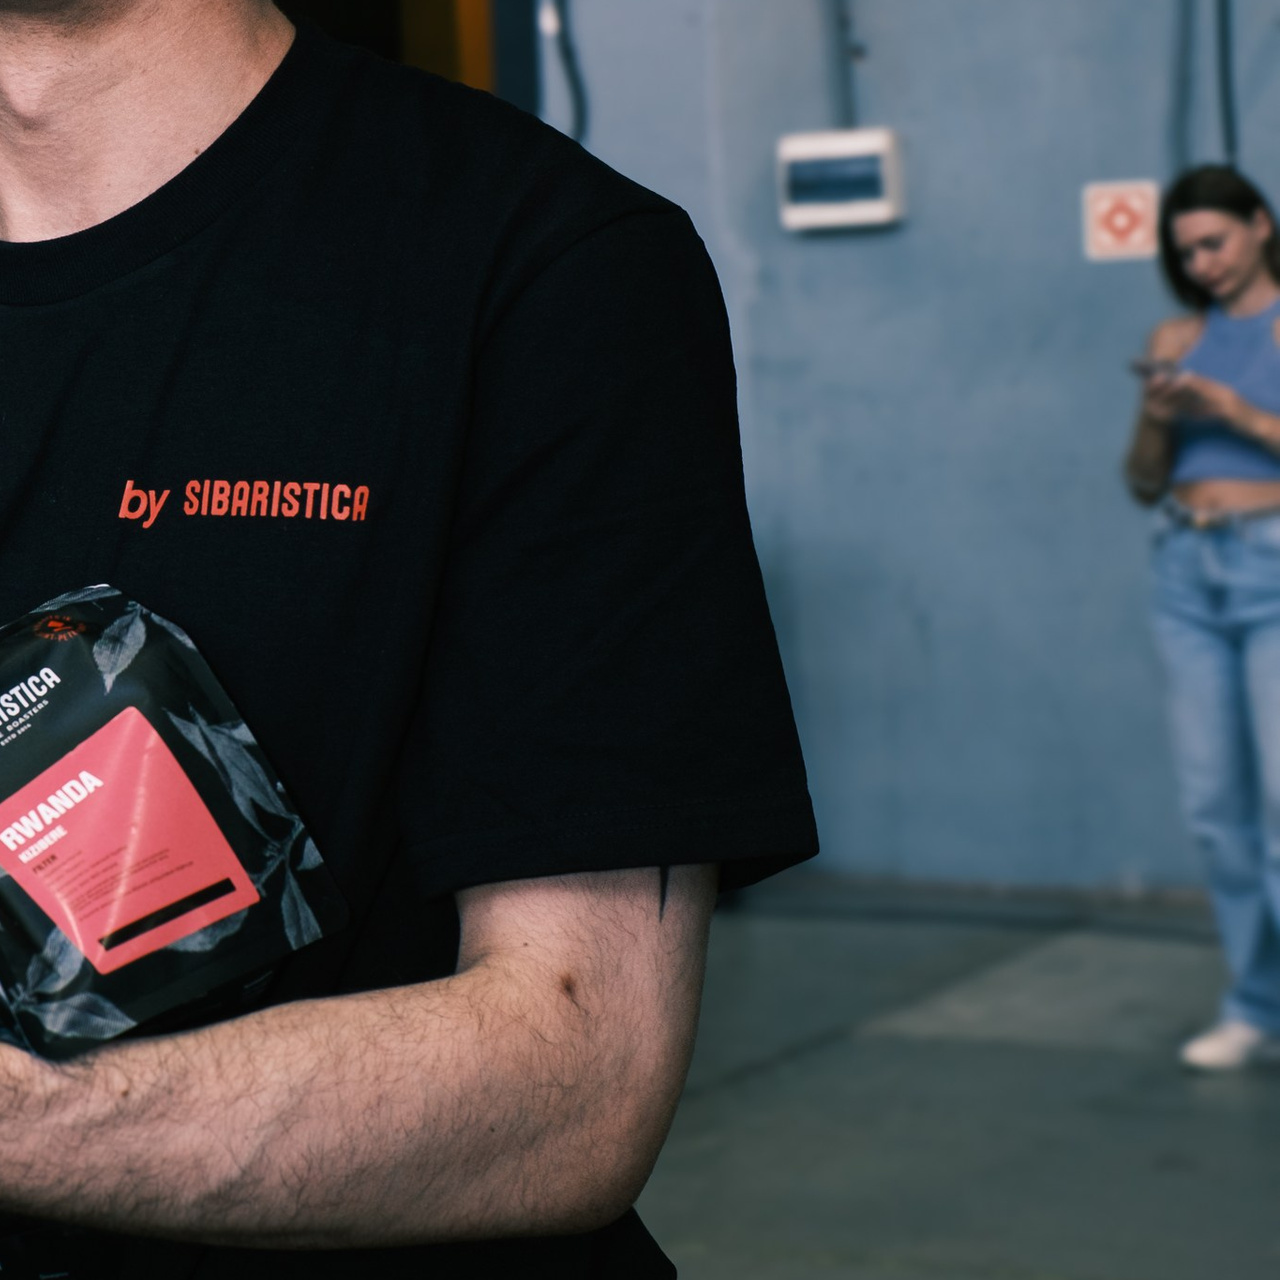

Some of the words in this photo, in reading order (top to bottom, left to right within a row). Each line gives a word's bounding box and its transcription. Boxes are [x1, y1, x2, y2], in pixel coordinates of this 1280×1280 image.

[118, 480, 170, 529] by
[183, 479, 370, 521] SIBARISTICA
[6, 699, 49, 732] ROASTERS
[32, 853, 57, 875] FILTER
